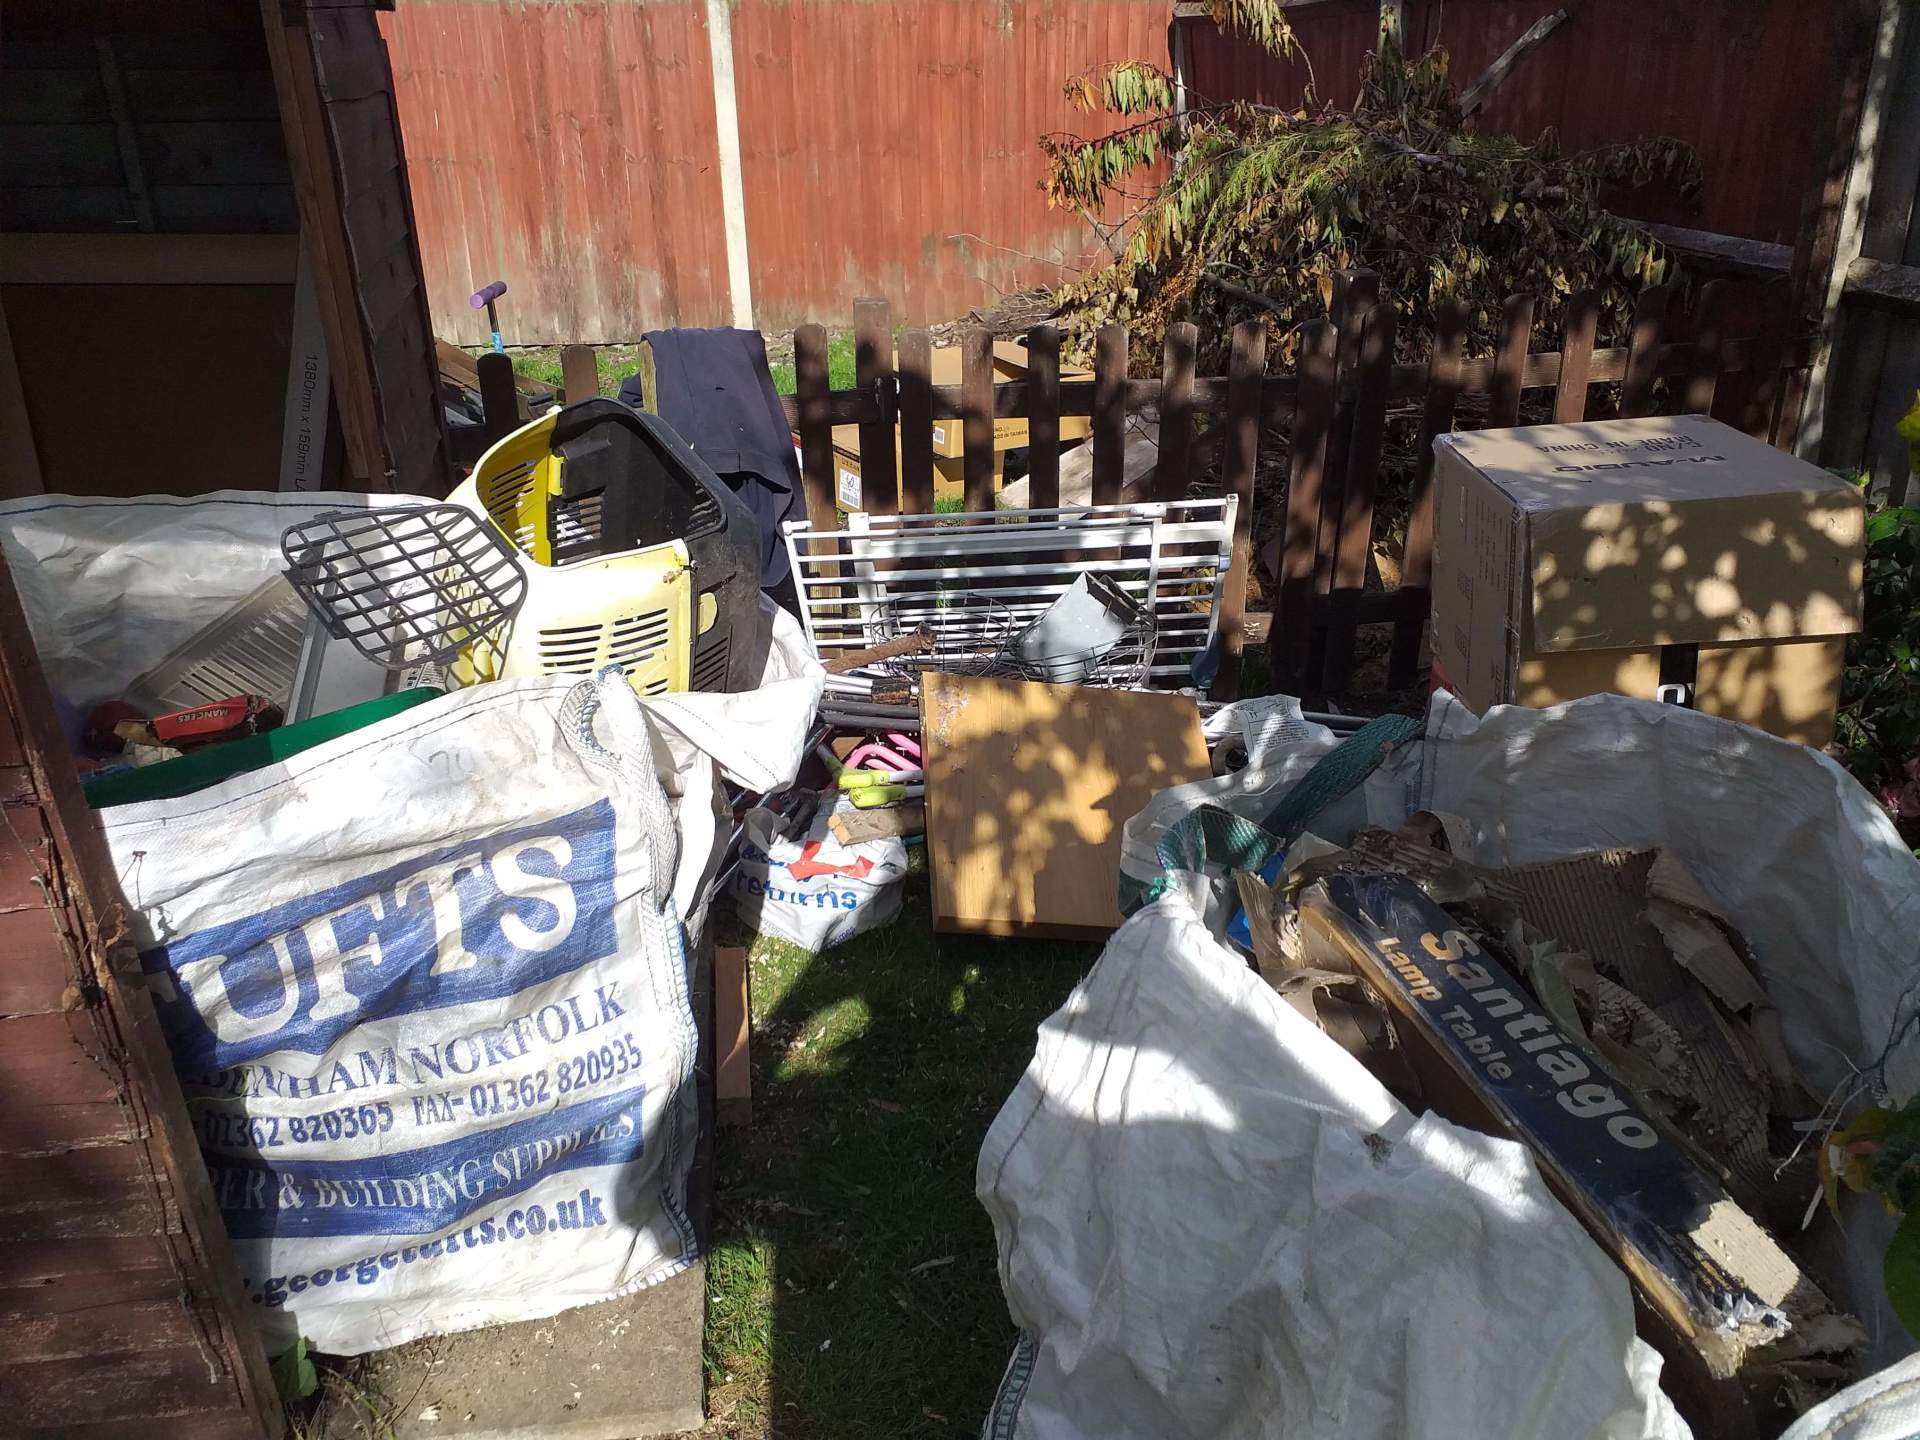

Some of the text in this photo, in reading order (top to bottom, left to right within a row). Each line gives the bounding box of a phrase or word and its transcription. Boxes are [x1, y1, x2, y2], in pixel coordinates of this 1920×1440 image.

[1536, 435, 1694, 453] MADE IN CHINA
[1553, 455, 1727, 472] M-AUDIO
[177, 708, 229, 724] MANGERS
[184, 981, 627, 1099] DENHAM NORFOLK
[1375, 937, 1512, 1080] Lamp Table
[1420, 930, 1659, 1149] Santiago
[204, 1110, 284, 1149] 01362
[288, 1101, 394, 1144] 820365
[469, 1069, 551, 1118] 01362
[556, 1031, 643, 1094] 820935
[277, 1173, 306, 1209] &
[315, 1158, 485, 1211] BUILDING
